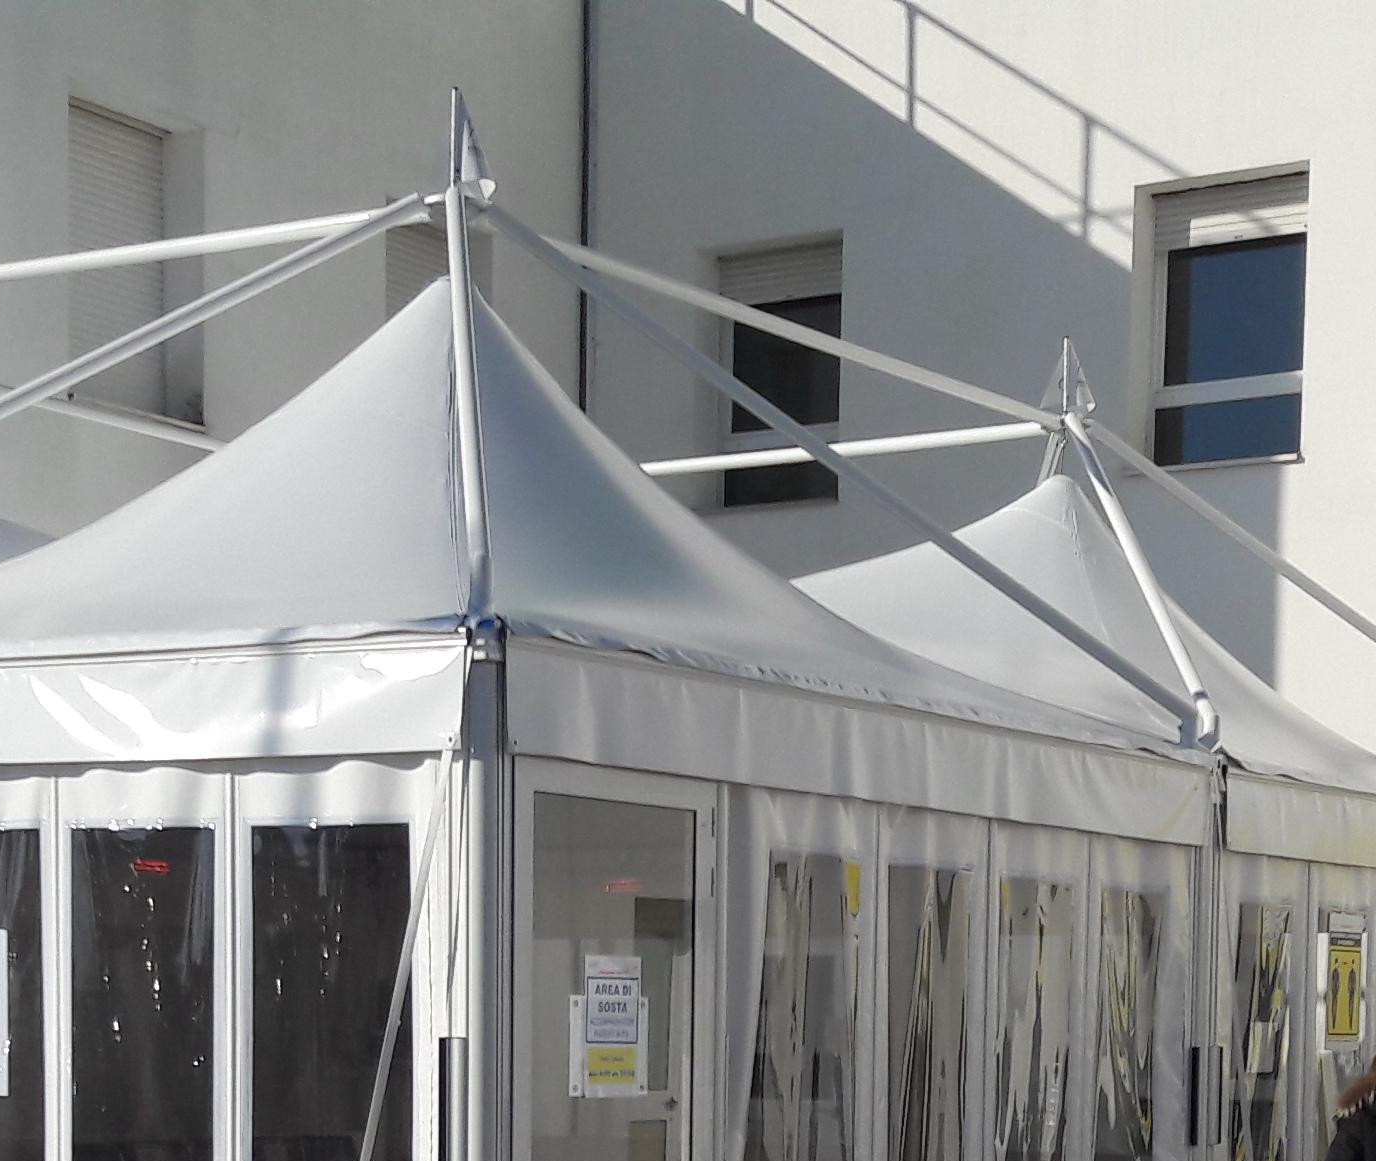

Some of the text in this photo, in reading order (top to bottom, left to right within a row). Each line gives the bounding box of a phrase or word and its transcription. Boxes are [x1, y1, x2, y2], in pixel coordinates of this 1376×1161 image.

[594, 984, 632, 997] AREA DI
[597, 1001, 628, 1013] SOSTA
